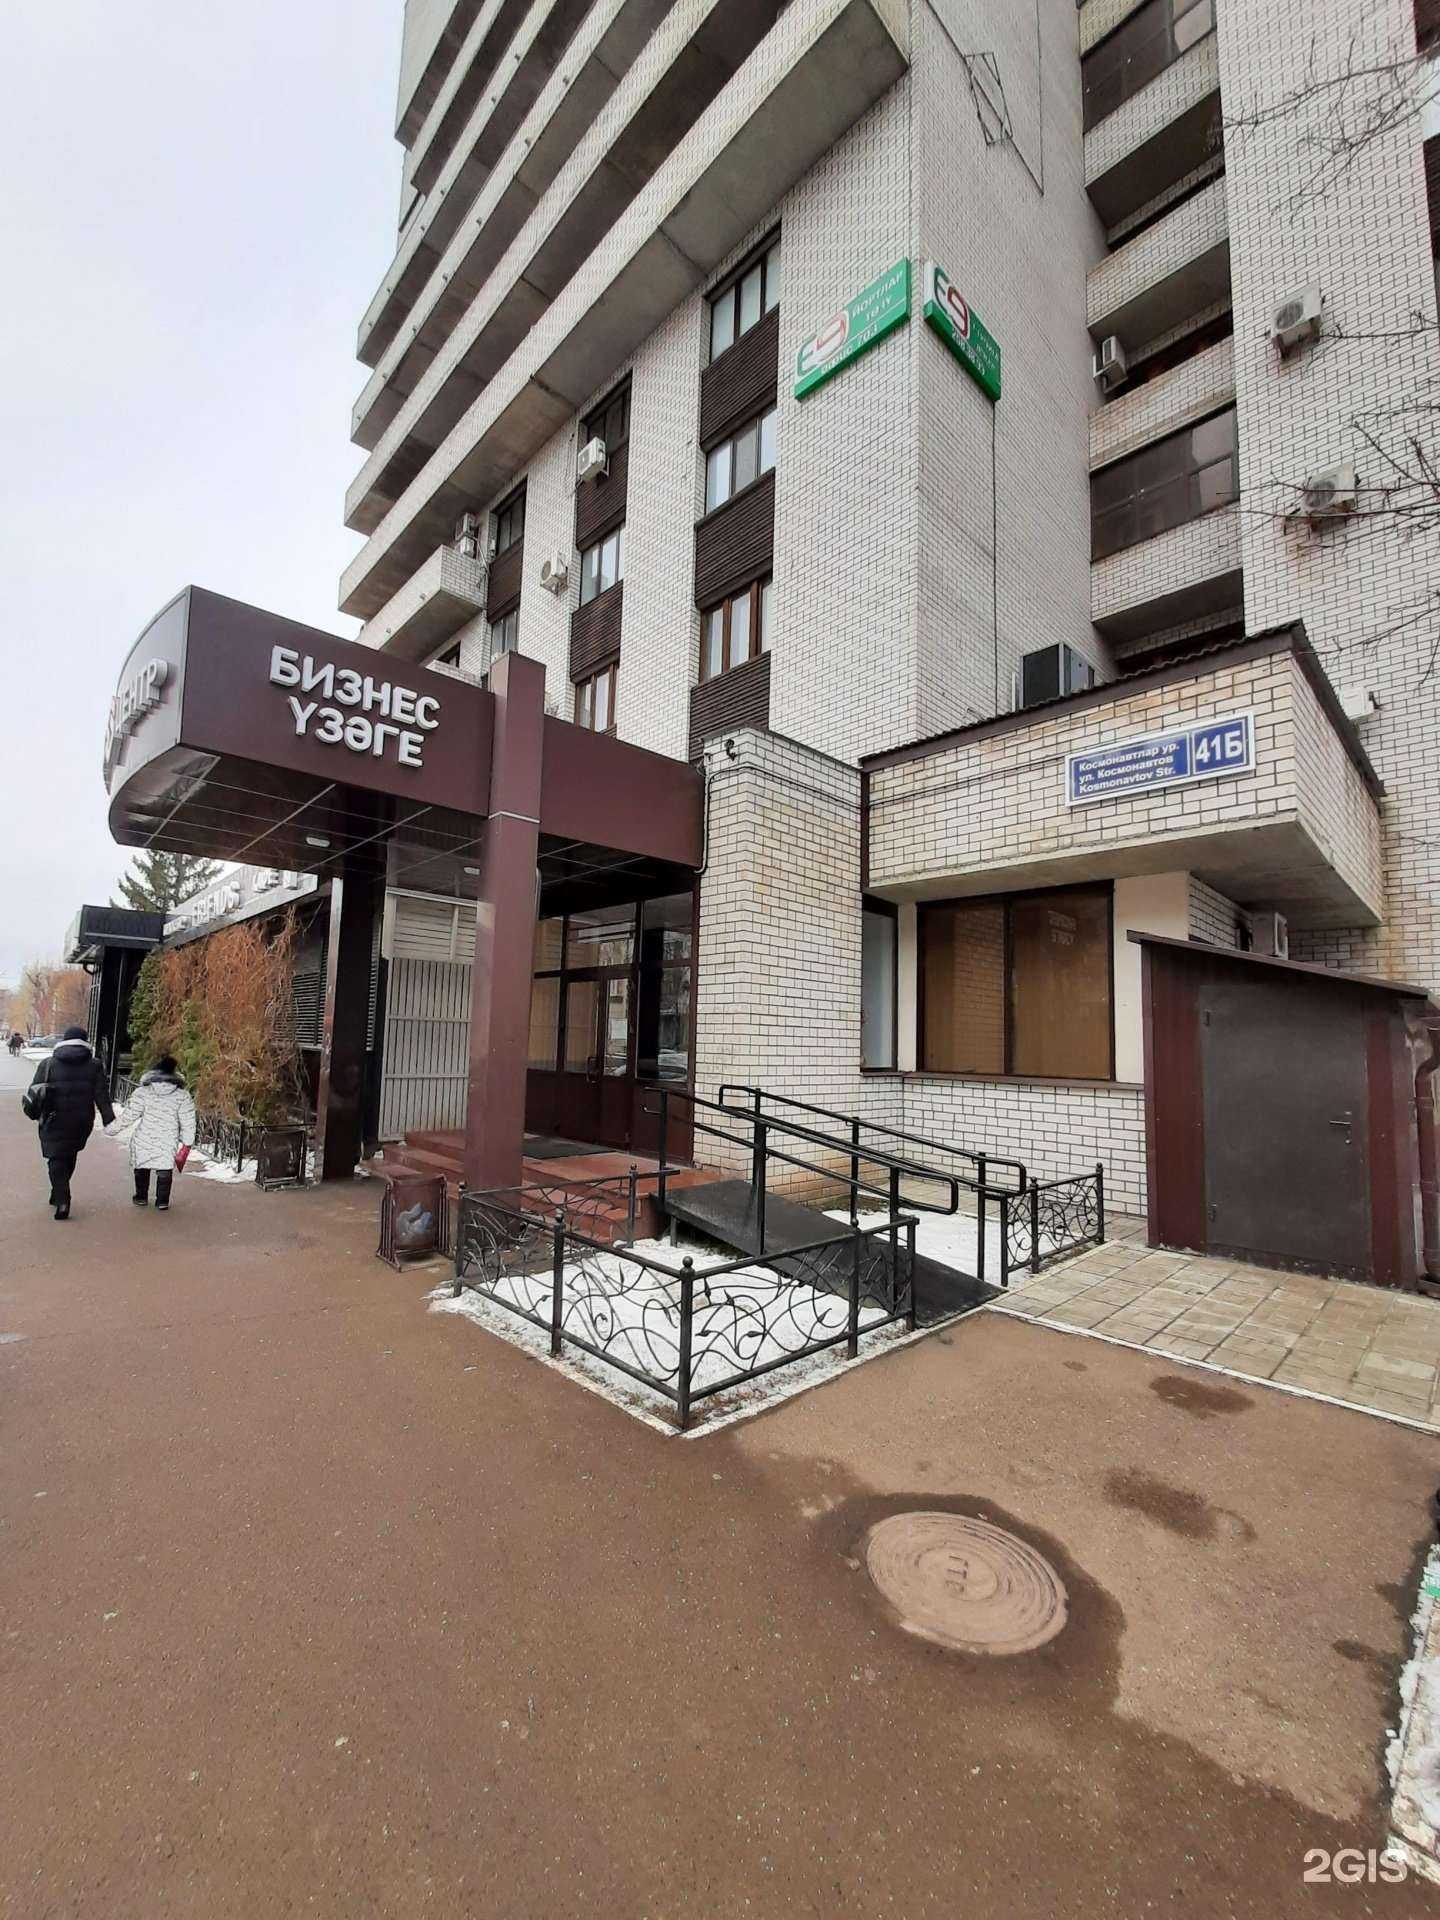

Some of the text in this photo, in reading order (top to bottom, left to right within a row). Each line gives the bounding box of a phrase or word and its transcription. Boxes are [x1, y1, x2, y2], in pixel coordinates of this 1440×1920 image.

[270, 645, 441, 730] БИЗНЕС
[288, 696, 424, 767] ҮЗӘГЕ
[1195, 730, 1242, 764] 41Б
[1079, 743, 1180, 772] Космонавтлар ур.
[1079, 757, 1174, 785] ул. Космонавтов
[1079, 766, 1177, 794] Kosmonavtov Str.
